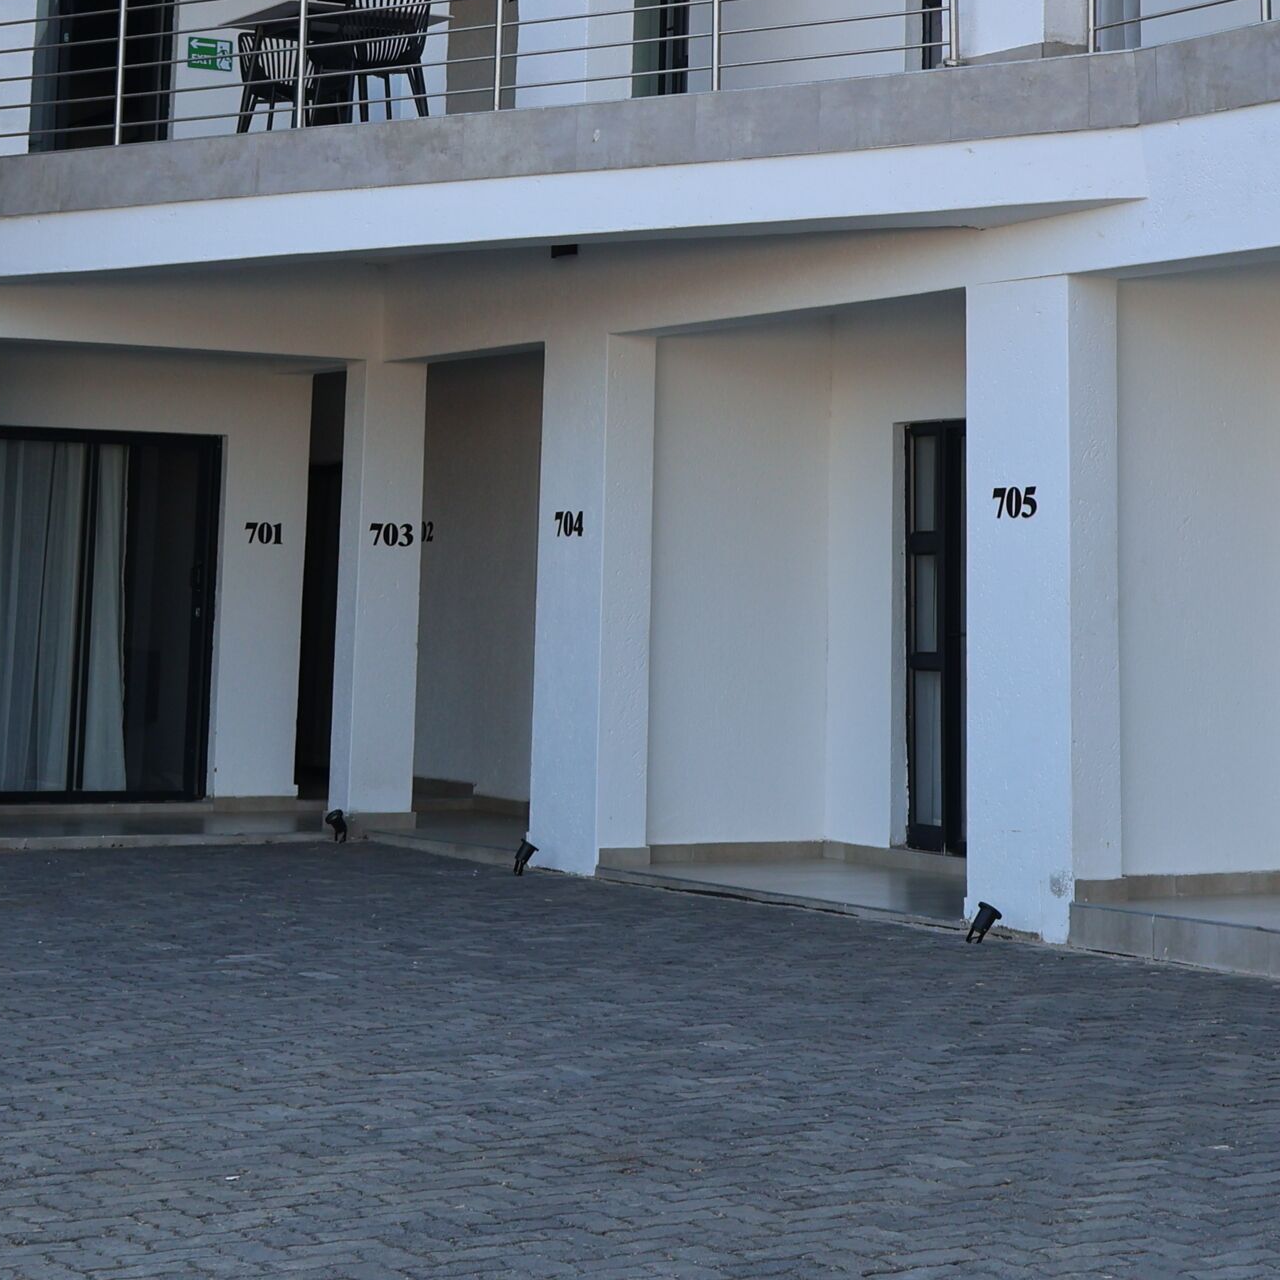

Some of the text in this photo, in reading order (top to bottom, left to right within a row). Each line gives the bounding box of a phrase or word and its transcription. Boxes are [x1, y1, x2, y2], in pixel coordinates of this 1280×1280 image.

[992, 486, 1037, 519] 705
[245, 521, 283, 545] 701
[369, 522, 414, 547] 703
[554, 510, 584, 537] 704
